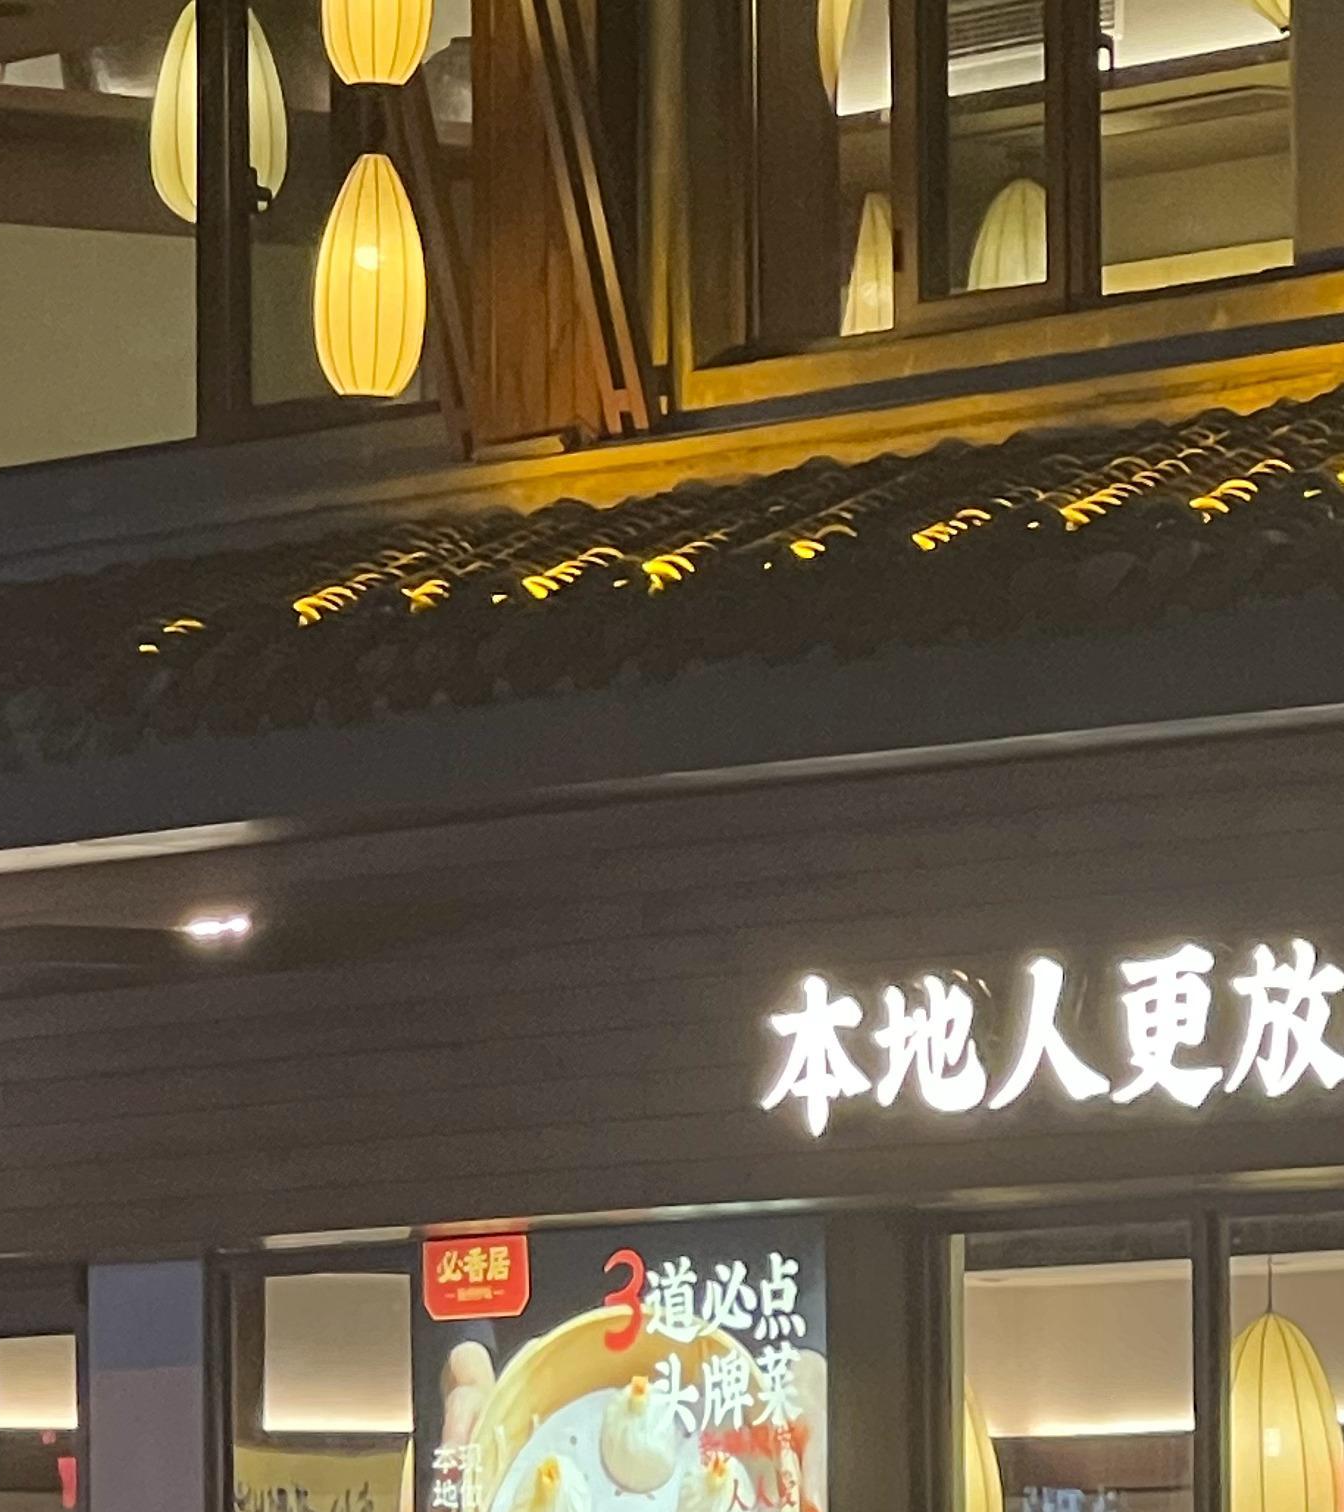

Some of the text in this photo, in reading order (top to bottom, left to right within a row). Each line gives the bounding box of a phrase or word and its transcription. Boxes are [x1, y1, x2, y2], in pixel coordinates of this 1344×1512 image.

[437, 1246, 510, 1284] 必香居
[604, 1248, 806, 1352] 3道必点
[649, 1341, 803, 1434] 头牌菜
